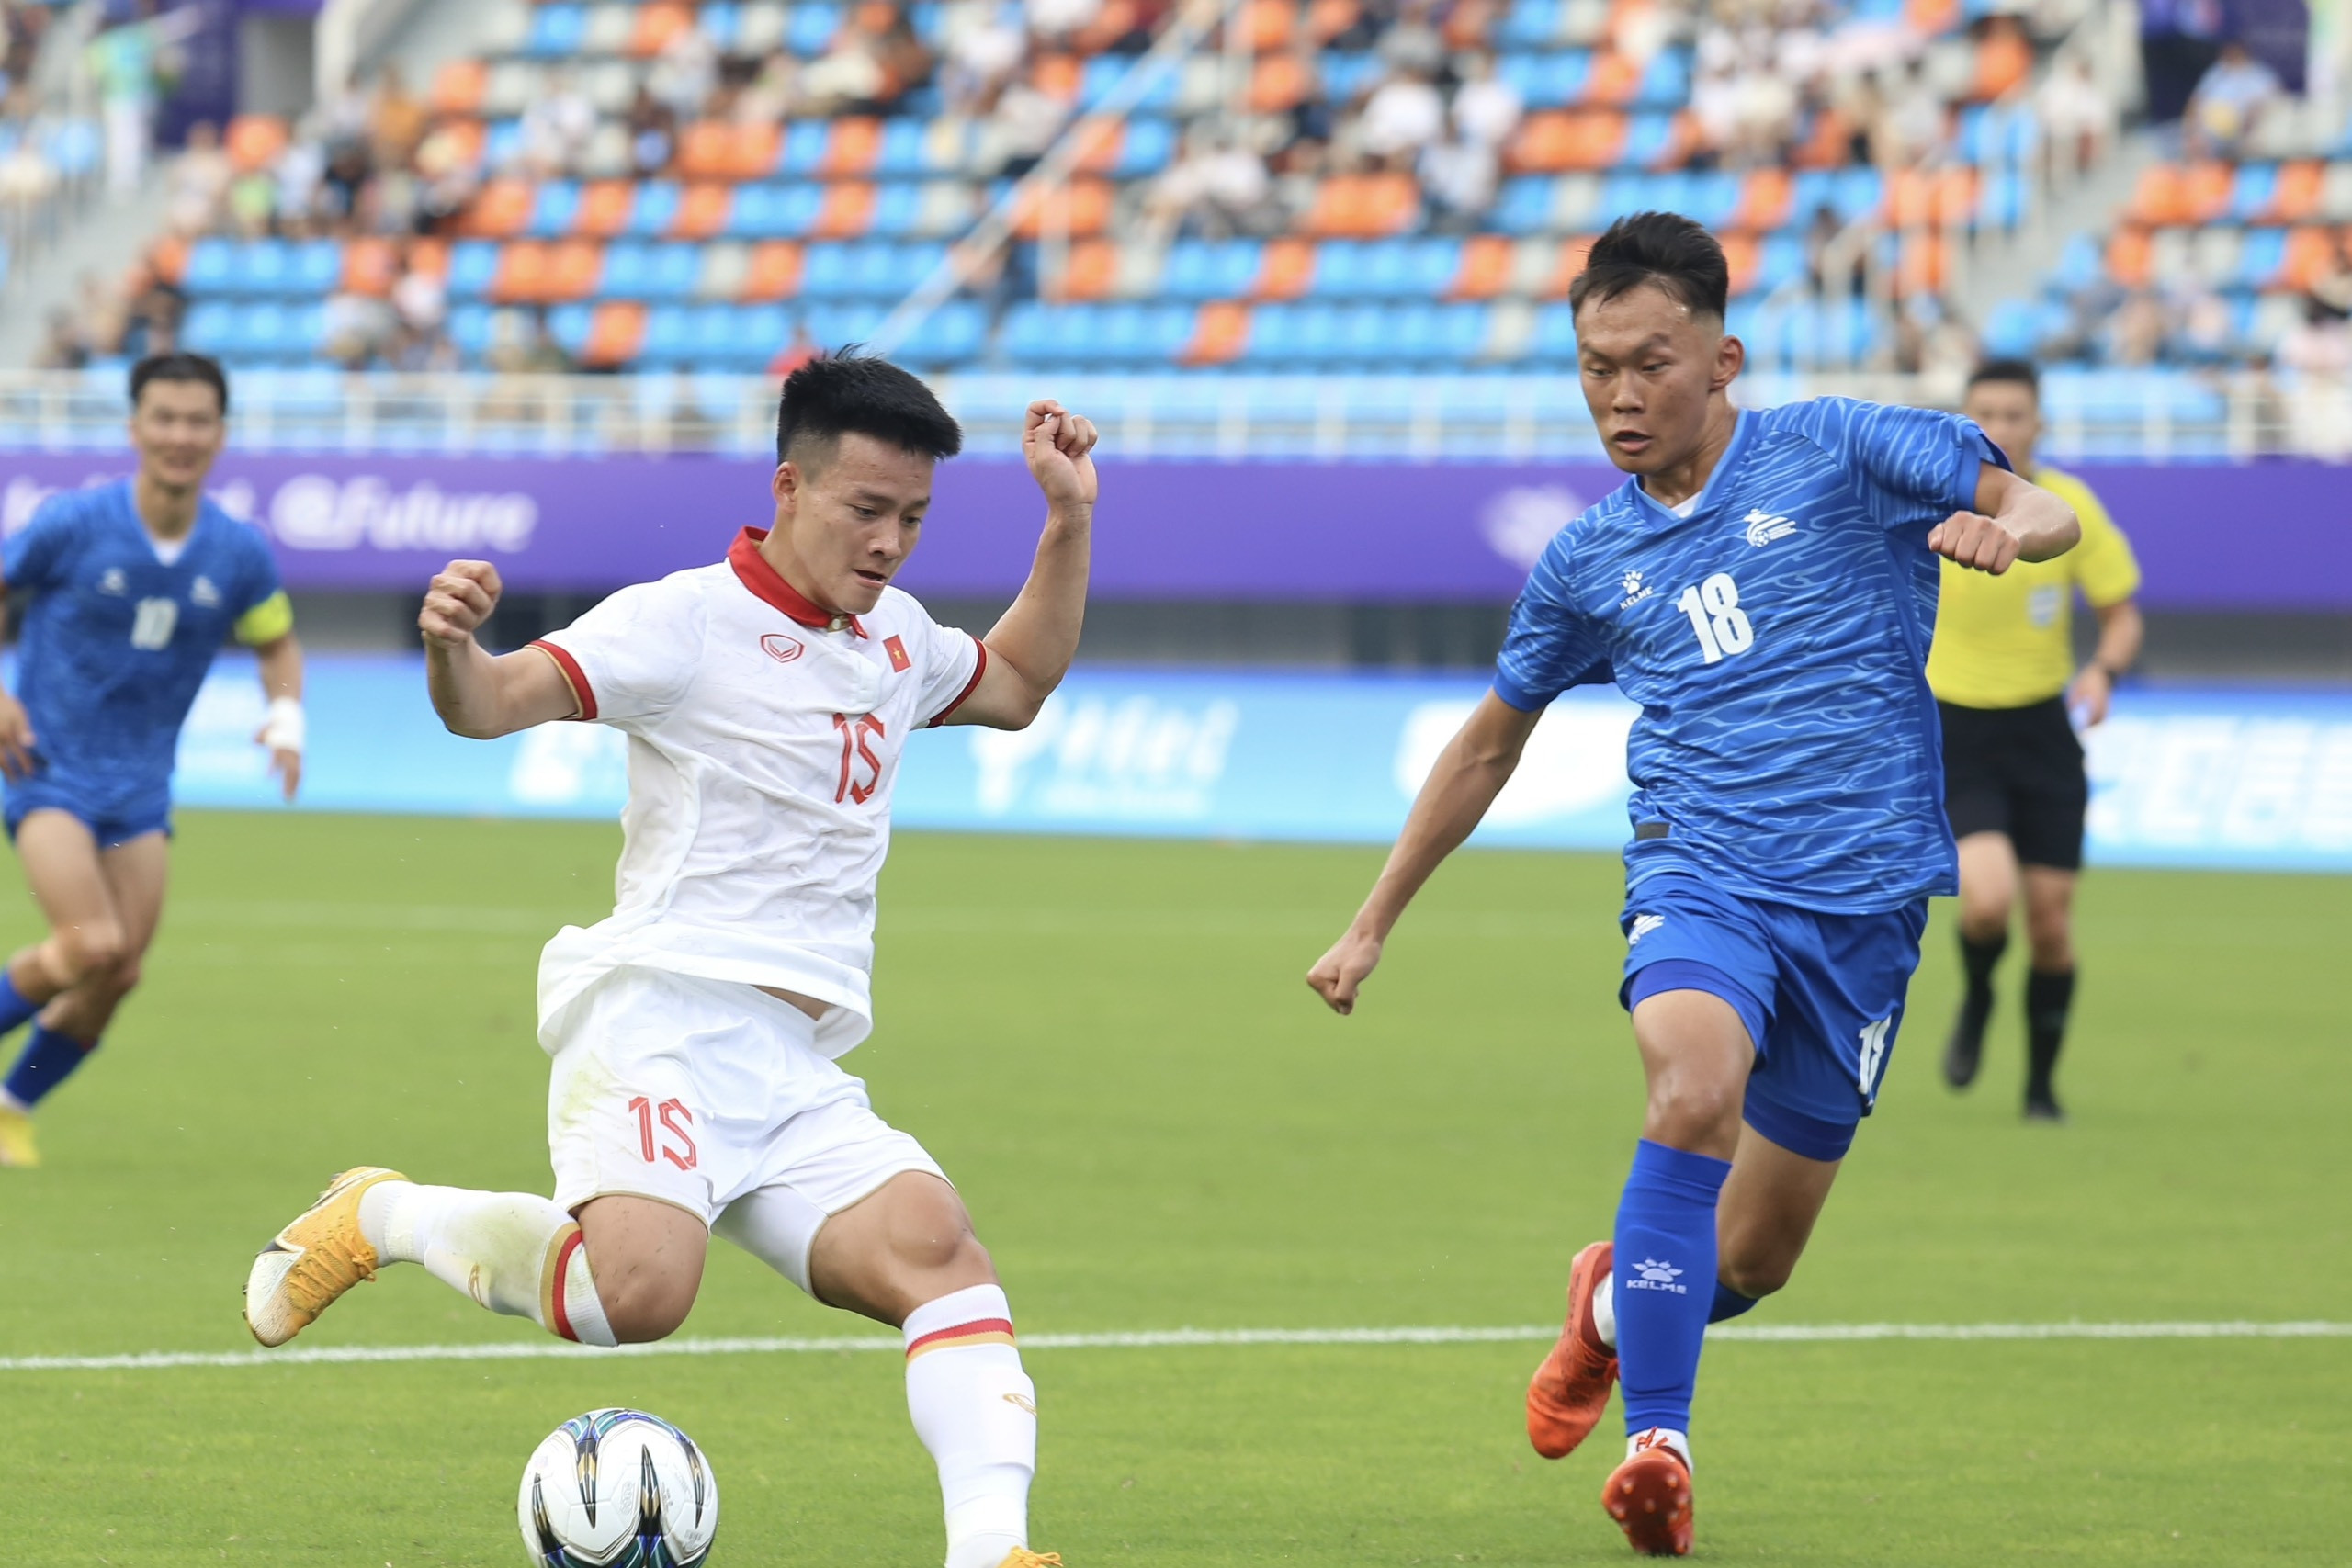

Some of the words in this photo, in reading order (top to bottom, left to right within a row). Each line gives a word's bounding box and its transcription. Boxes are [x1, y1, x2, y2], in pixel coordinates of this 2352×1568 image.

[130, 597, 179, 651] 10
[1620, 586, 1654, 610] KELME
[1676, 572, 1755, 664] 18
[832, 711, 885, 806] 15
[628, 1096, 697, 1171] 15
[1625, 1279, 1687, 1295] KELME
